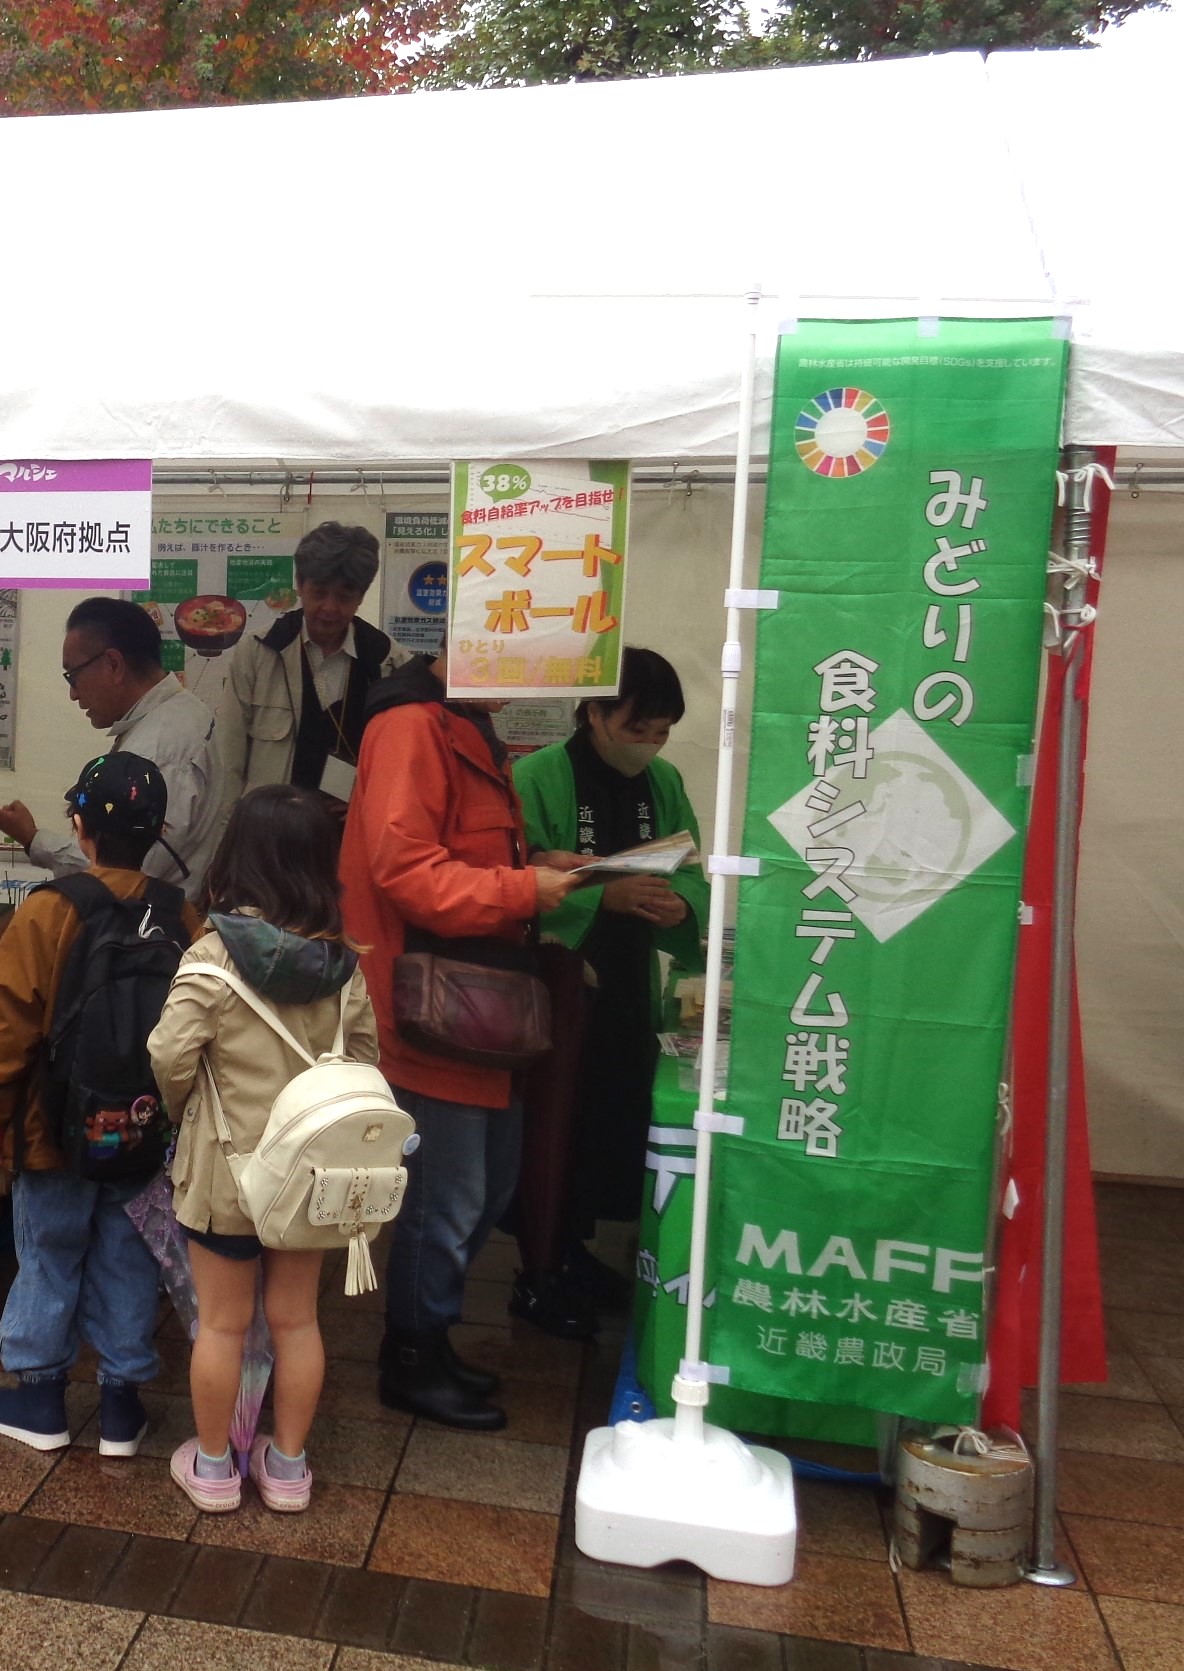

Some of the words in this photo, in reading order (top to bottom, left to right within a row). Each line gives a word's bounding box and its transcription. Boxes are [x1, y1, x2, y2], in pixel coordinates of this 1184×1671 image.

[482, 474, 527, 492] 38%
[461, 487, 624, 526] 食料自給率アップを目指せ！
[0, 521, 131, 554] 大阪府拠点
[455, 534, 623, 578] スマート
[484, 589, 618, 634] ボール
[912, 470, 988, 729] みどりの
[459, 639, 506, 654] ひとり
[637, 802, 653, 840] 近畿
[776, 649, 880, 1160] 食料システム戦略
[735, 1223, 984, 1294] MAFF
[731, 1277, 980, 1341] 農林水産省
[756, 1324, 948, 1377] 近畿農政局
